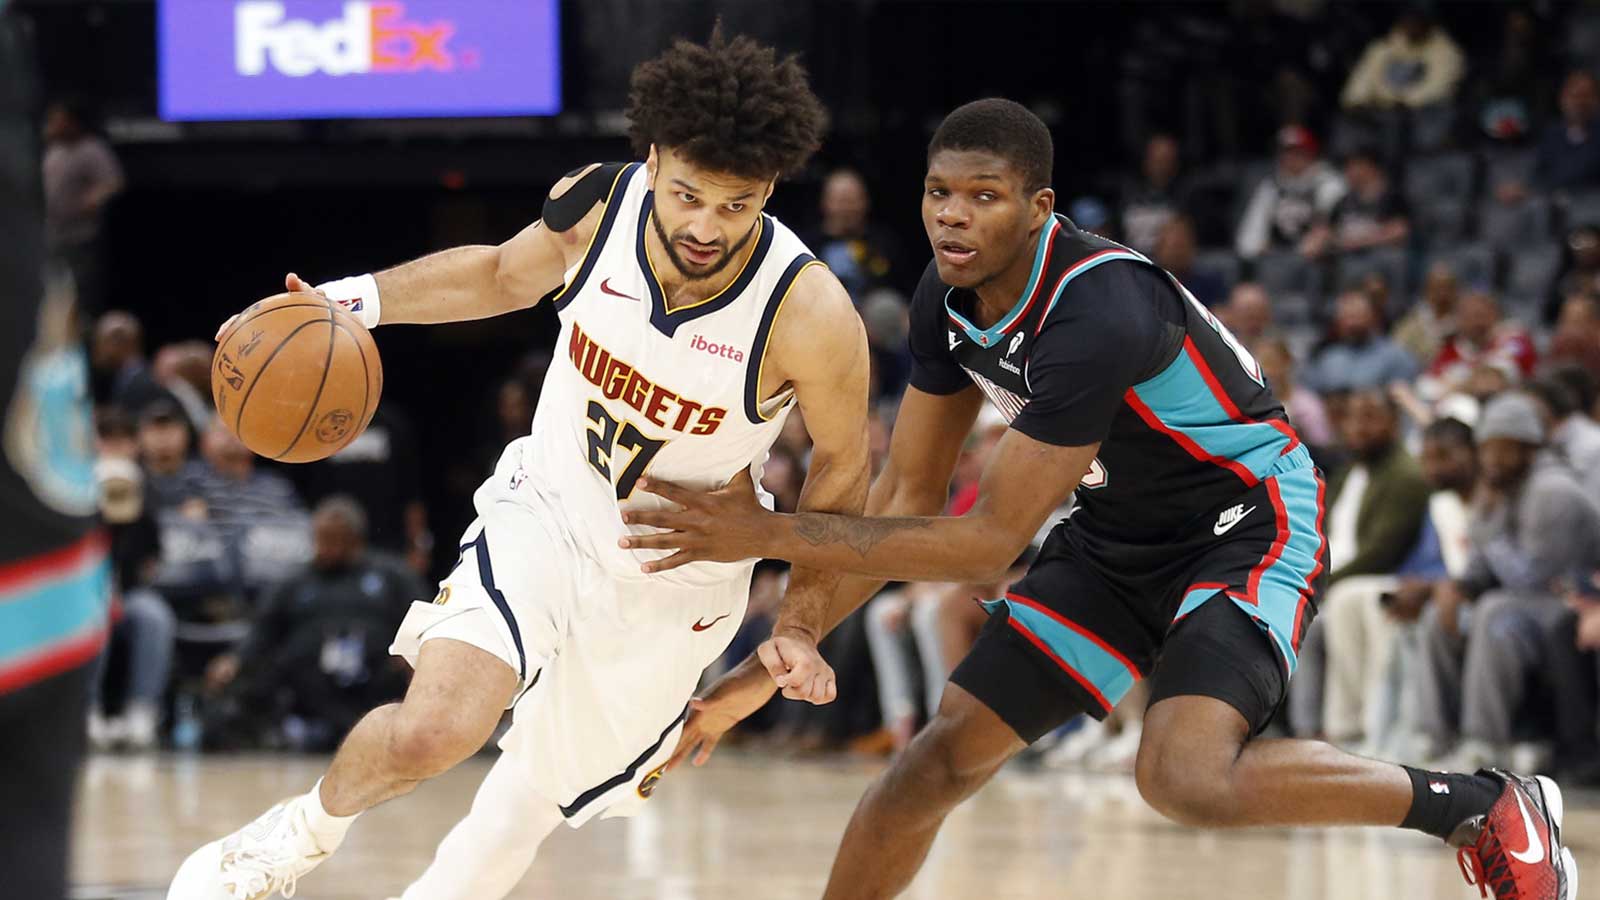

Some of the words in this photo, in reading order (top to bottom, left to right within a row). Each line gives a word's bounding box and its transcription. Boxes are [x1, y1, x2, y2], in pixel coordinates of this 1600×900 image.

[234, 0, 456, 77] FedEx
[569, 320, 728, 435] NUGGETS
[690, 334, 743, 363] ibotta
[585, 399, 670, 502] 27
[1219, 503, 1244, 525] NIKE
